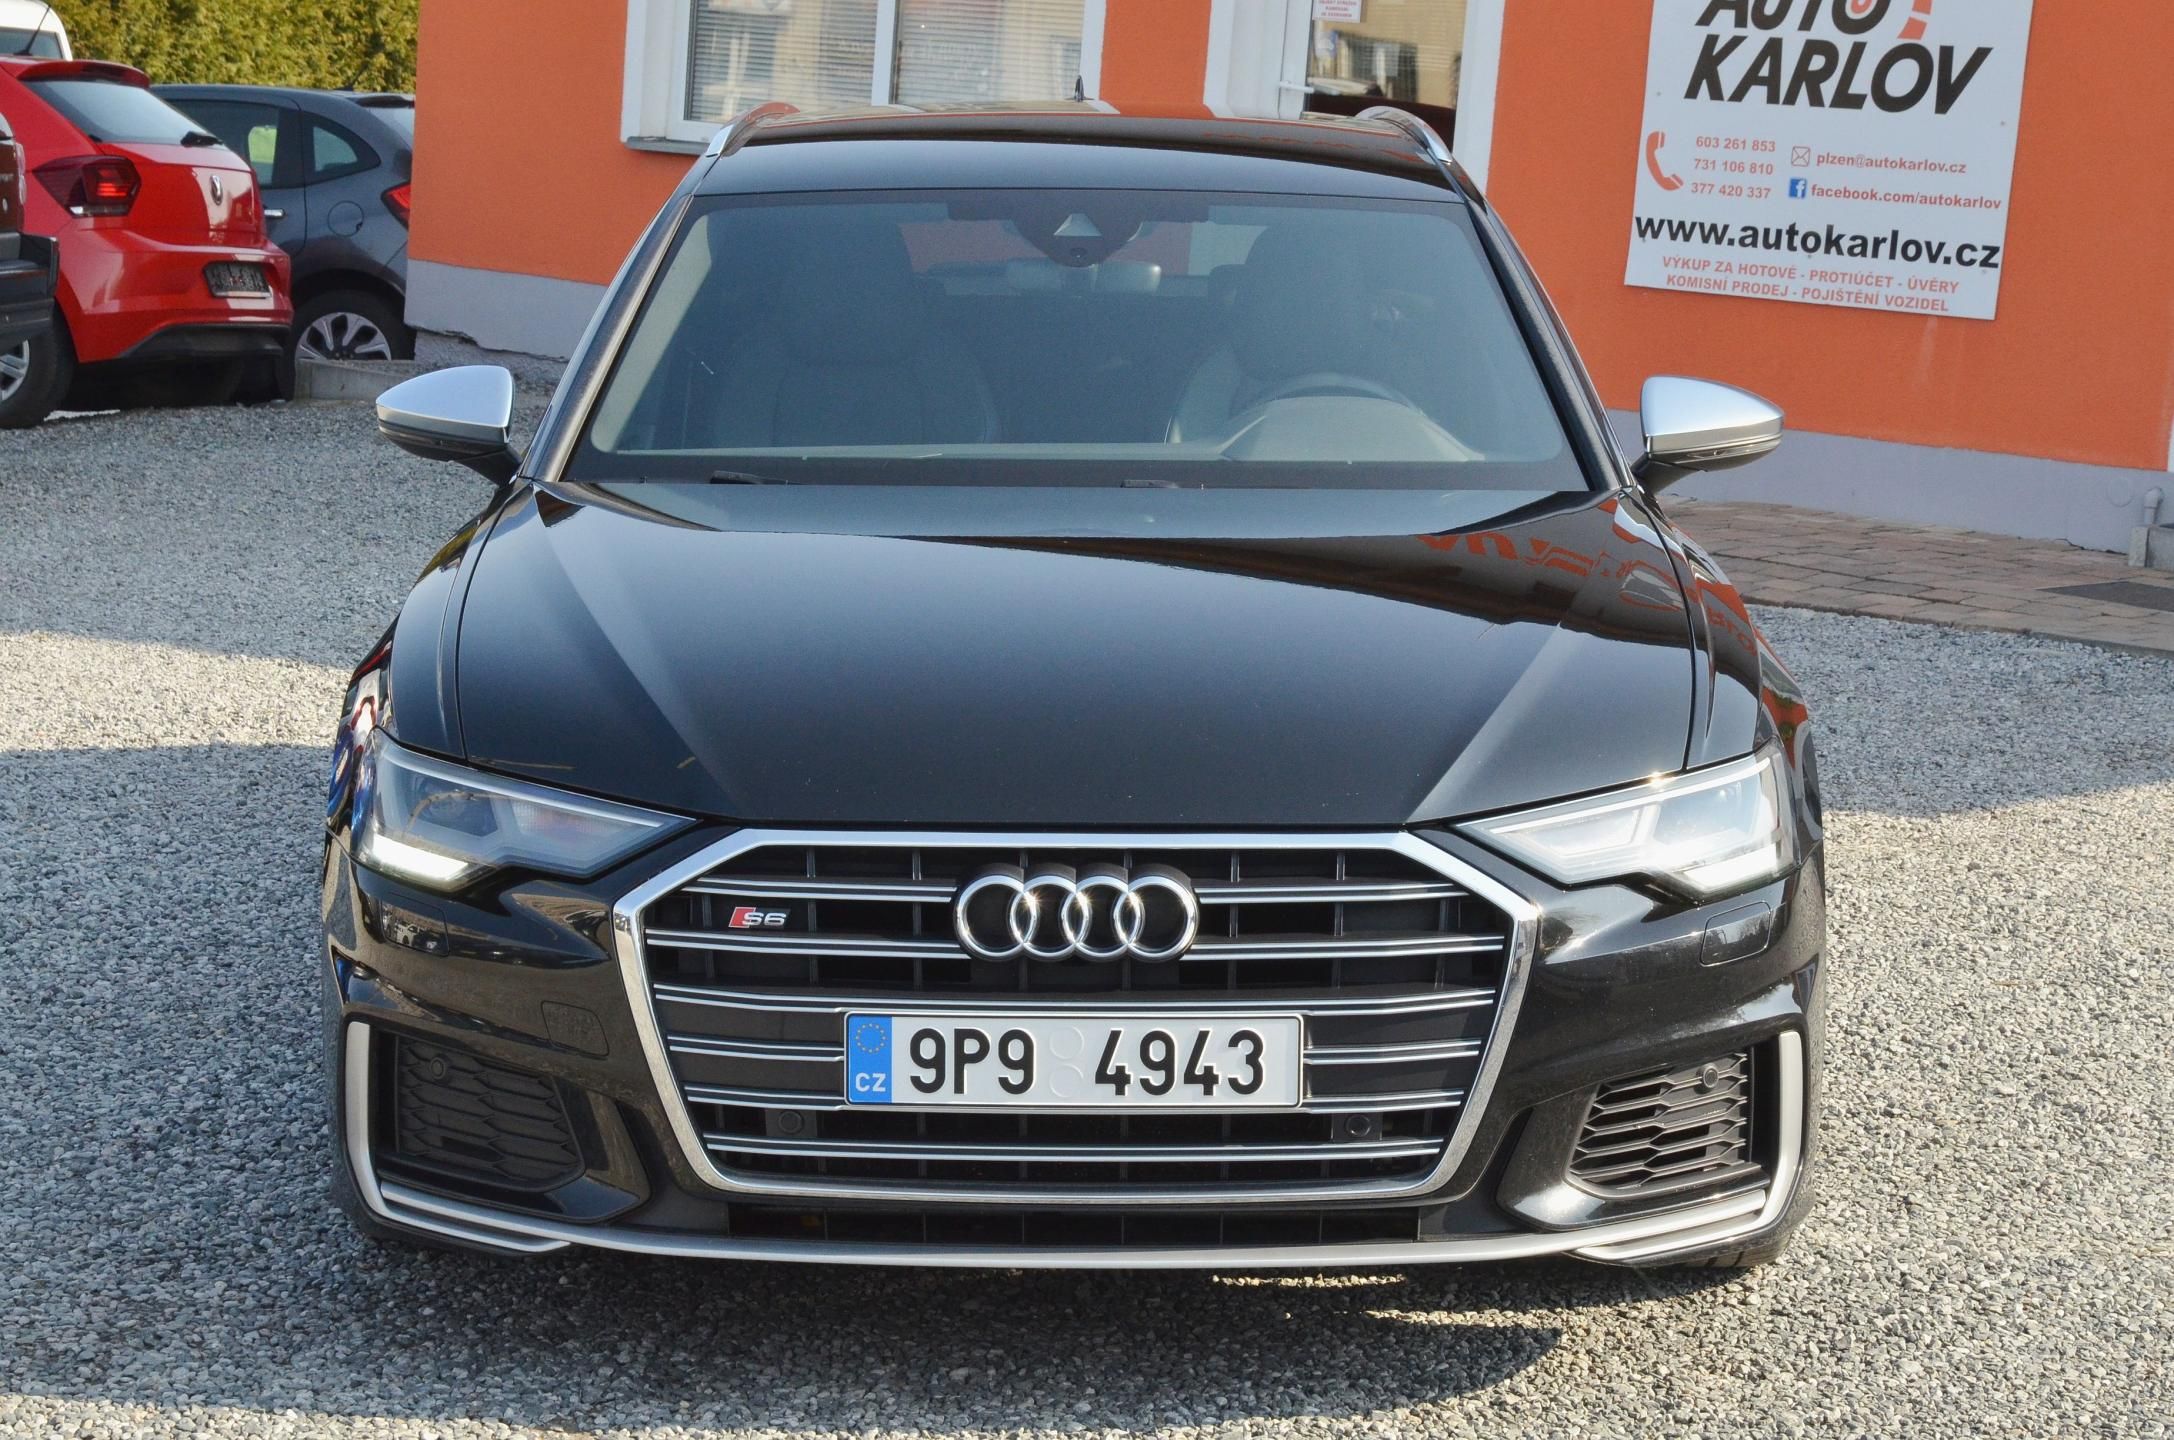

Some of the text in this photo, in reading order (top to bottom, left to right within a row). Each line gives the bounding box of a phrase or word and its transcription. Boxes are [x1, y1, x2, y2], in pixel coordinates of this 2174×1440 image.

[1684, 33, 1994, 115] KARLOV
[1696, 136, 1776, 152] 603 261 853
[1694, 158, 1774, 176] 731 106 810
[1816, 152, 1967, 174] plzen@autokarlov.cz
[1691, 182, 1771, 199] 377 420 337
[1810, 184, 2002, 209] facebook.com/autokarlov
[1635, 216, 2001, 269] www.autokarlov.cz
[1662, 254, 1711, 271] VÝKUP
[1714, 261, 1734, 274] ZA
[1738, 263, 1798, 280] HOTOVÉ
[1809, 269, 1895, 289] PROTIÚČET
[1907, 275, 1960, 294] ÚVĚRY
[1666, 274, 1729, 292] KOMISNÍ
[1732, 281, 1788, 297] PRODEJ
[1801, 286, 1881, 306] POJIŠTĚNÍ
[1884, 294, 1949, 312] VOZIDEL
[741, 911, 787, 926] S6
[909, 1027, 1265, 1097] 9P9 4943
[855, 1072, 887, 1093] CZ
